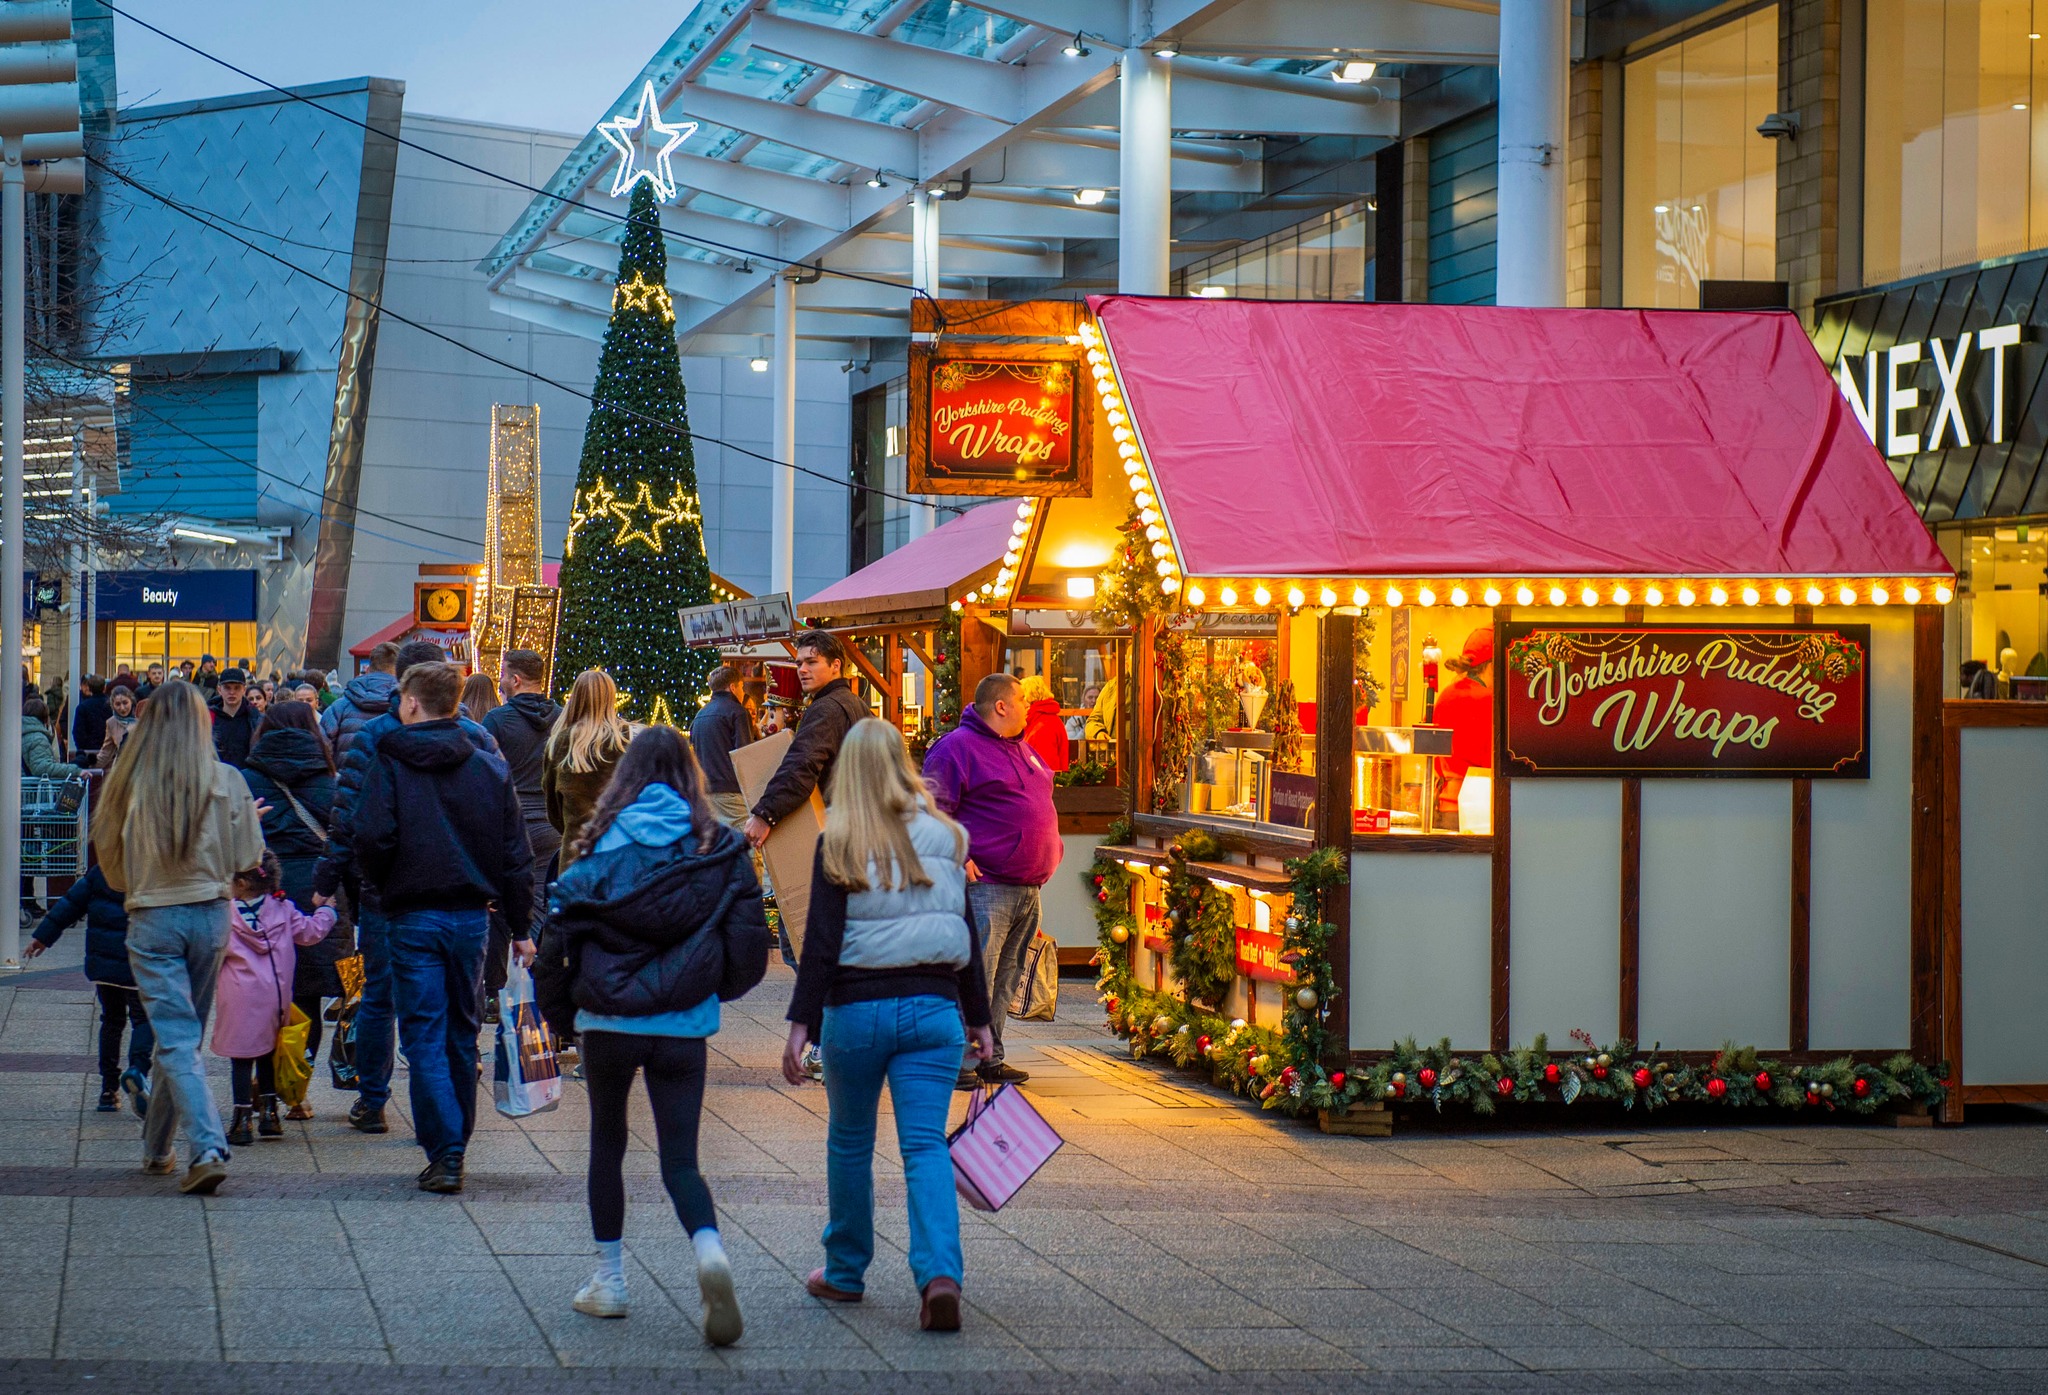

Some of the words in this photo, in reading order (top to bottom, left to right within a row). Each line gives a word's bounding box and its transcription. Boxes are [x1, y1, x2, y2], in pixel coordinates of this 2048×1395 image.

[934, 398, 1006, 433] Yorkshire
[1007, 397, 1069, 437] Pudding
[1841, 323, 2021, 457] NEXT
[949, 418, 1056, 464] Wraps
[142, 586, 178, 607] Beauty
[1528, 643, 1692, 726] Yorkshire
[1695, 639, 1838, 723] Pudding
[1592, 679, 1780, 758] Wraps
